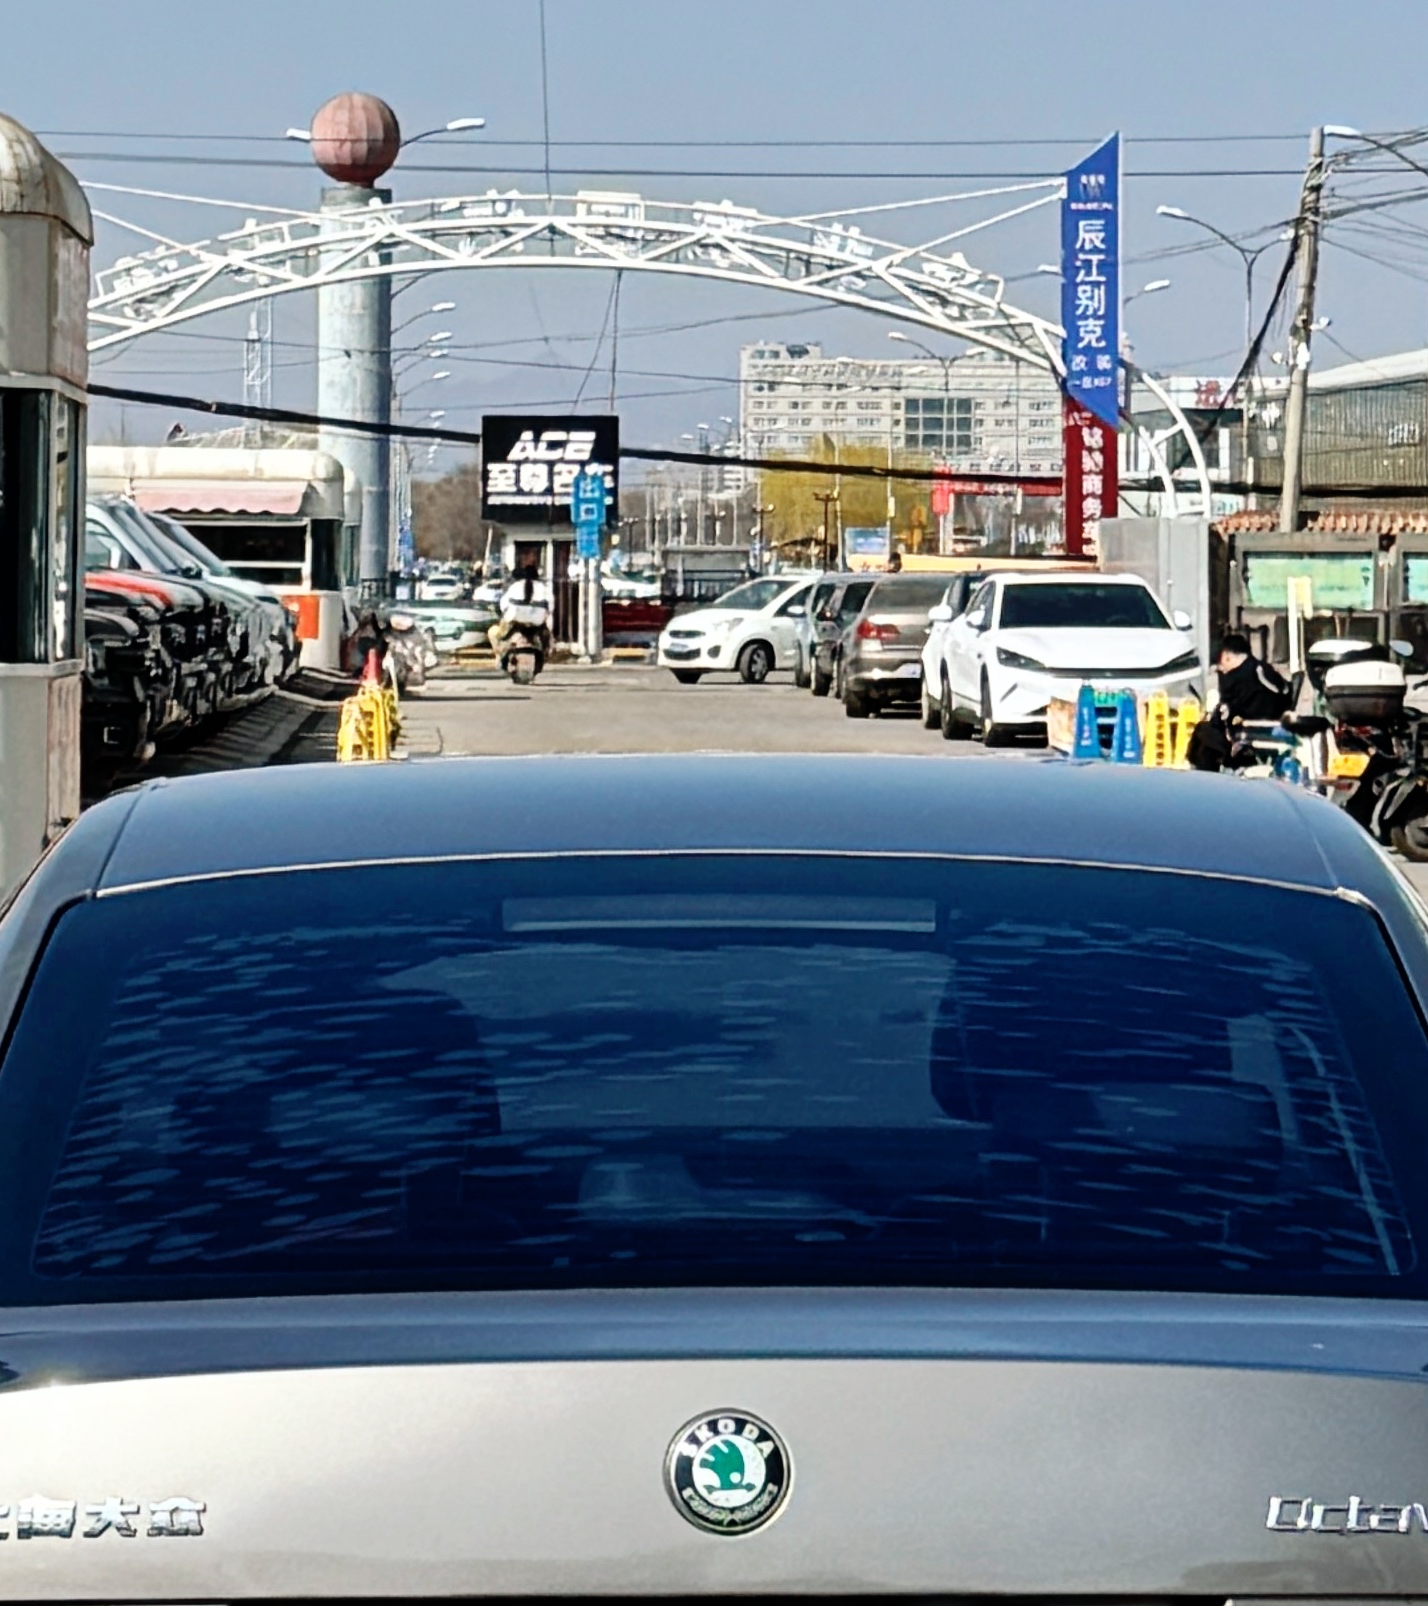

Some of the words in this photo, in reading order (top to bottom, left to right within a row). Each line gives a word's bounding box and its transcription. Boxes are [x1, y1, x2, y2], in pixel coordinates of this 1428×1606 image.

[1075, 219, 1107, 348] 辰江别克
[506, 430, 597, 461] ACE
